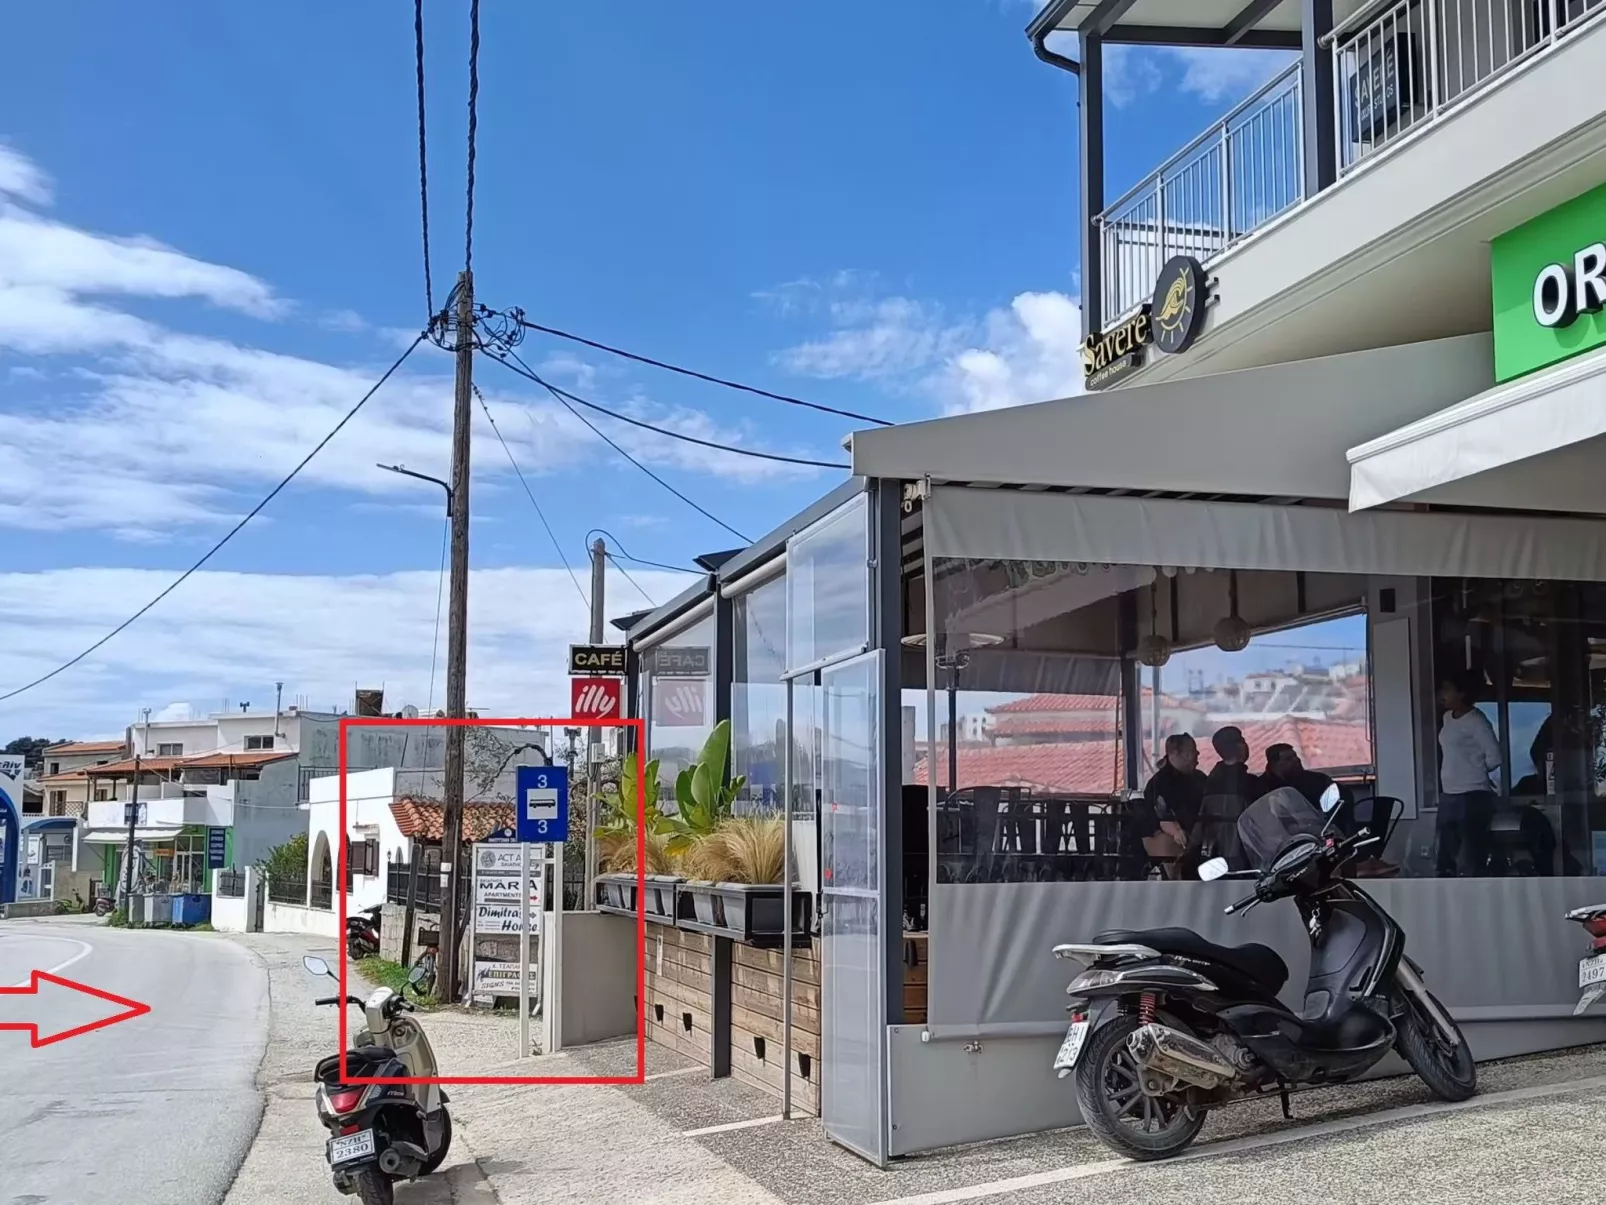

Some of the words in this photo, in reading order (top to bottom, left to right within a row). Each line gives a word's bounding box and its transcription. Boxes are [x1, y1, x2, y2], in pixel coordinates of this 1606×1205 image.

[1355, 48, 1393, 107] SAEÉ
[1533, 242, 1606, 327] OR
[1090, 371, 1109, 386] coffee
[1109, 359, 1127, 375] house
[574, 650, 623, 666] CAFÉ
[575, 684, 617, 719] illy
[537, 774, 548, 789] 3
[537, 819, 548, 834] 3
[498, 853, 514, 862] ACT
[480, 879, 538, 891] MARA
[488, 970, 536, 980] ΕΠΙΓΡΑΣ
[1581, 966, 1604, 983] 2497
[481, 981, 505, 989] SIGNS
[336, 1143, 369, 1159] 2380
